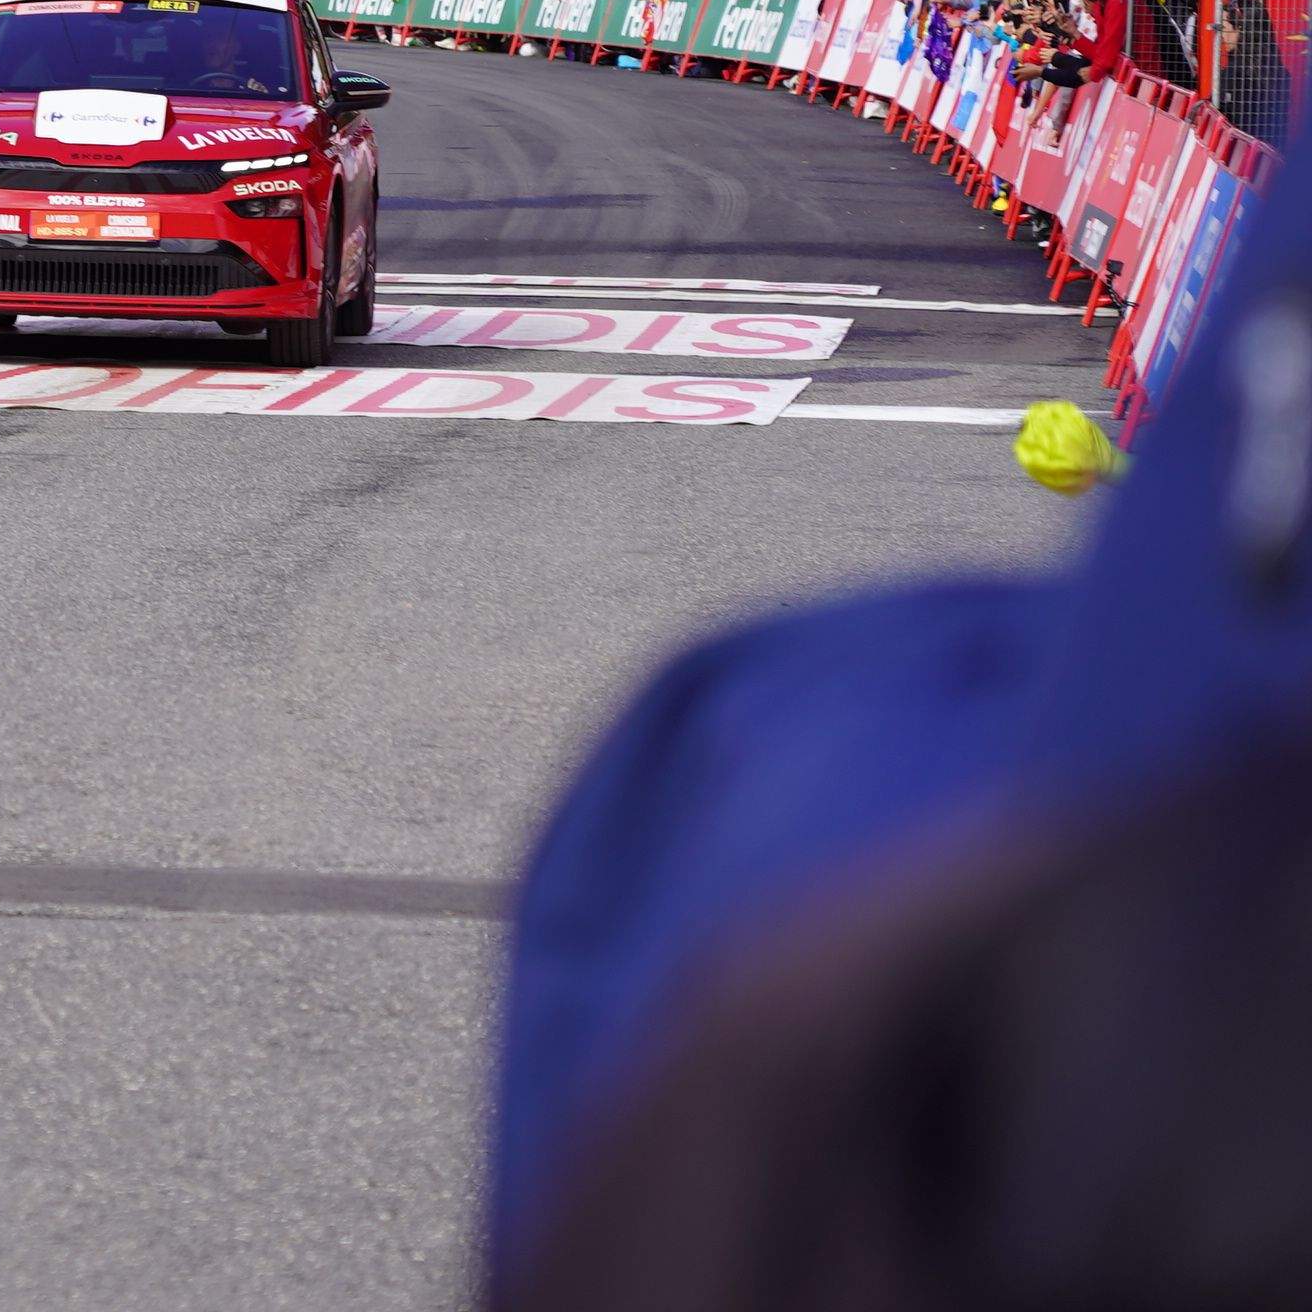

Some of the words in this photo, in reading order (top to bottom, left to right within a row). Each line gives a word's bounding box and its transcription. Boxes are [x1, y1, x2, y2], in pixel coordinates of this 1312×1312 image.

[71, 112, 129, 123] Carrefour
[177, 134, 213, 151] LA
[208, 125, 298, 145] VUELTA
[83, 196, 146, 208] ELECTRIC
